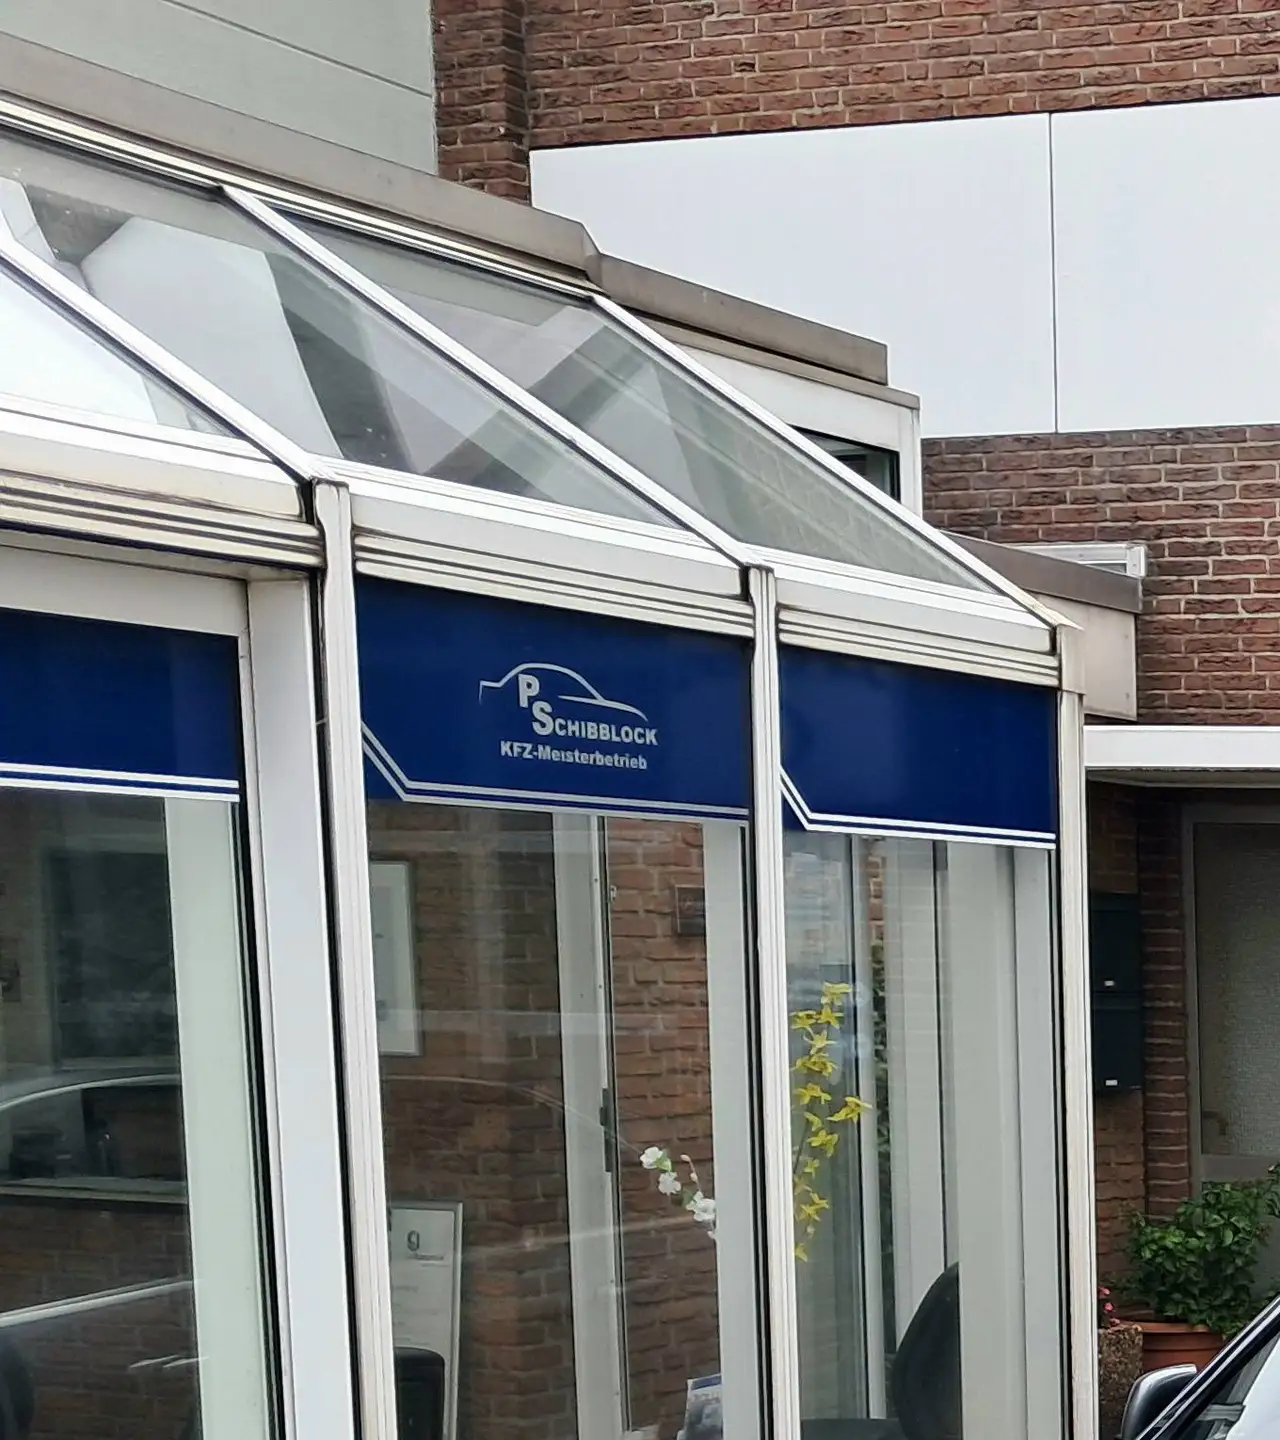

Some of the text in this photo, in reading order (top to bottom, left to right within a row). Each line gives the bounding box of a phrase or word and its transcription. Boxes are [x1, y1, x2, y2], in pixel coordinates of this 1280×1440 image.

[518, 673, 540, 708] P
[532, 700, 659, 746] SCHIBBLOCK
[500, 740, 648, 770] KFZ-Meisterbetrieb
